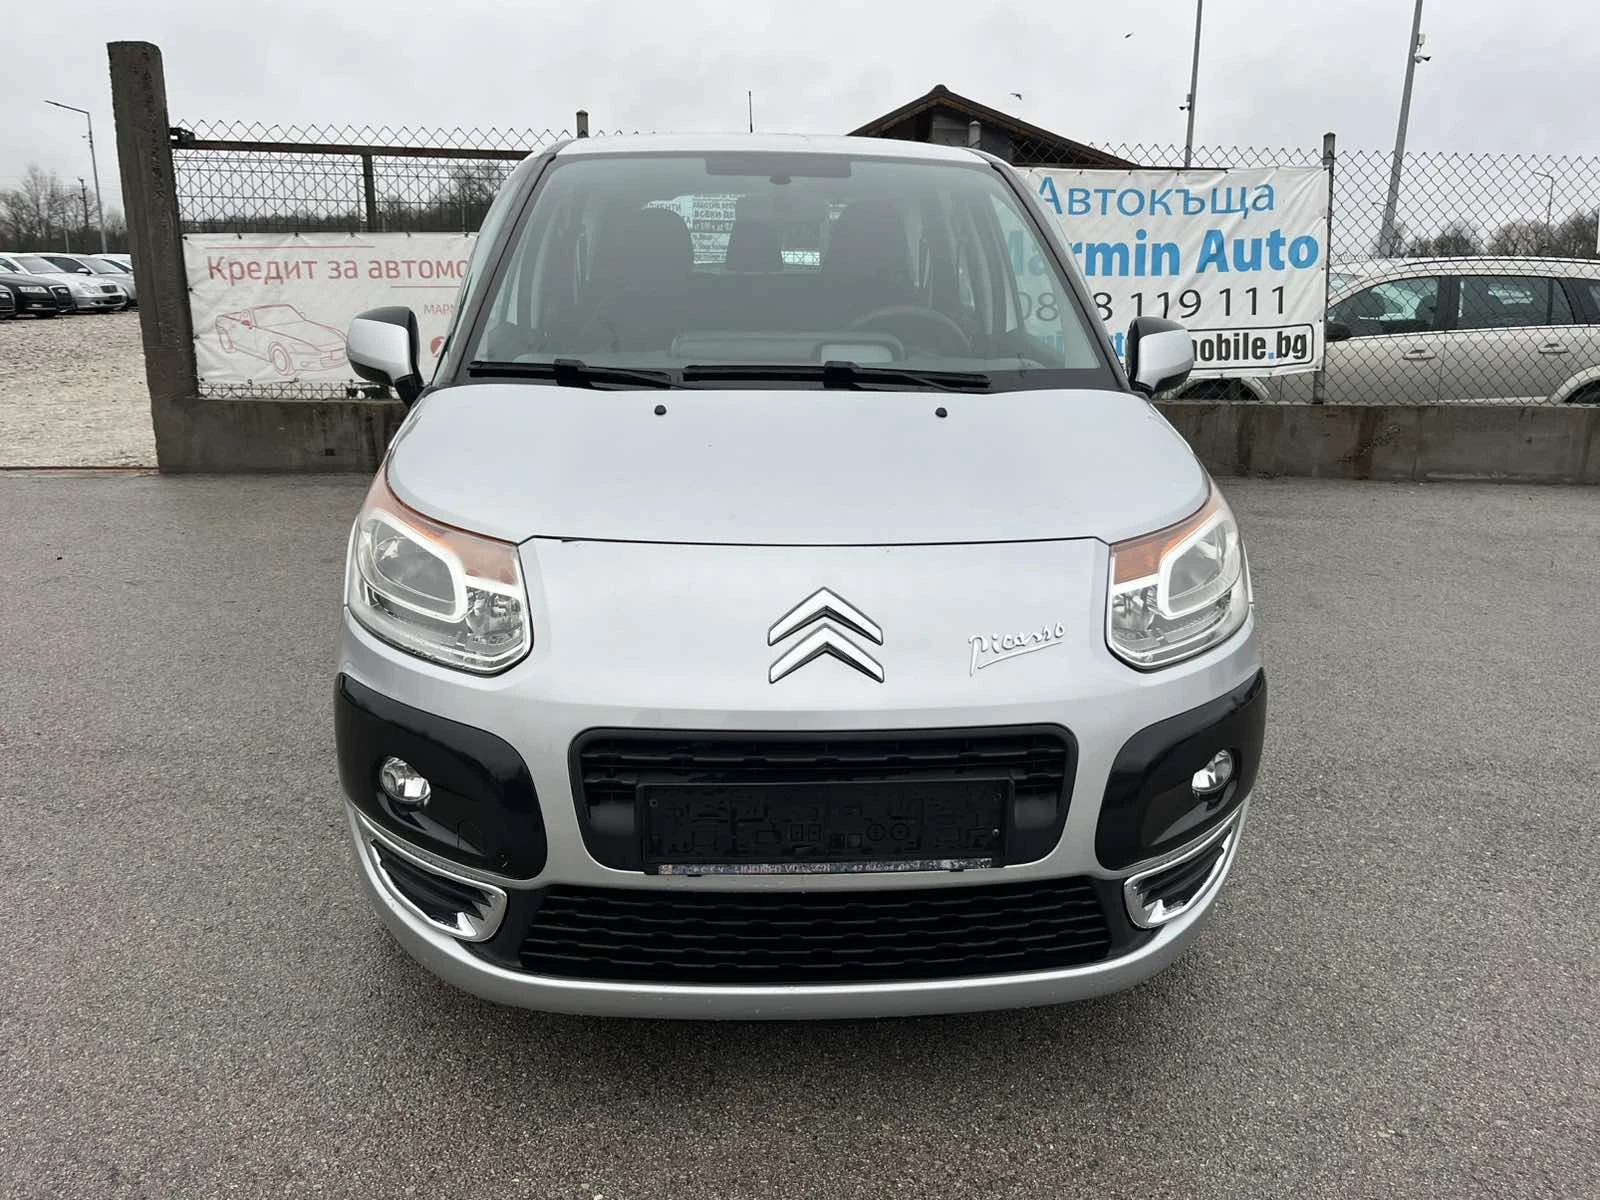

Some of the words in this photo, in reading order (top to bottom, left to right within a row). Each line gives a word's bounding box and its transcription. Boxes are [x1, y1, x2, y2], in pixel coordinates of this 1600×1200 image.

[1039, 176, 1275, 219] Автокъща
[207, 255, 318, 285] Кредит
[328, 260, 358, 280] за
[1196, 228, 1319, 273] Auto
[1131, 289, 1202, 319] 119
[1219, 286, 1285, 317] 111
[968, 621, 1065, 678] Picasso
